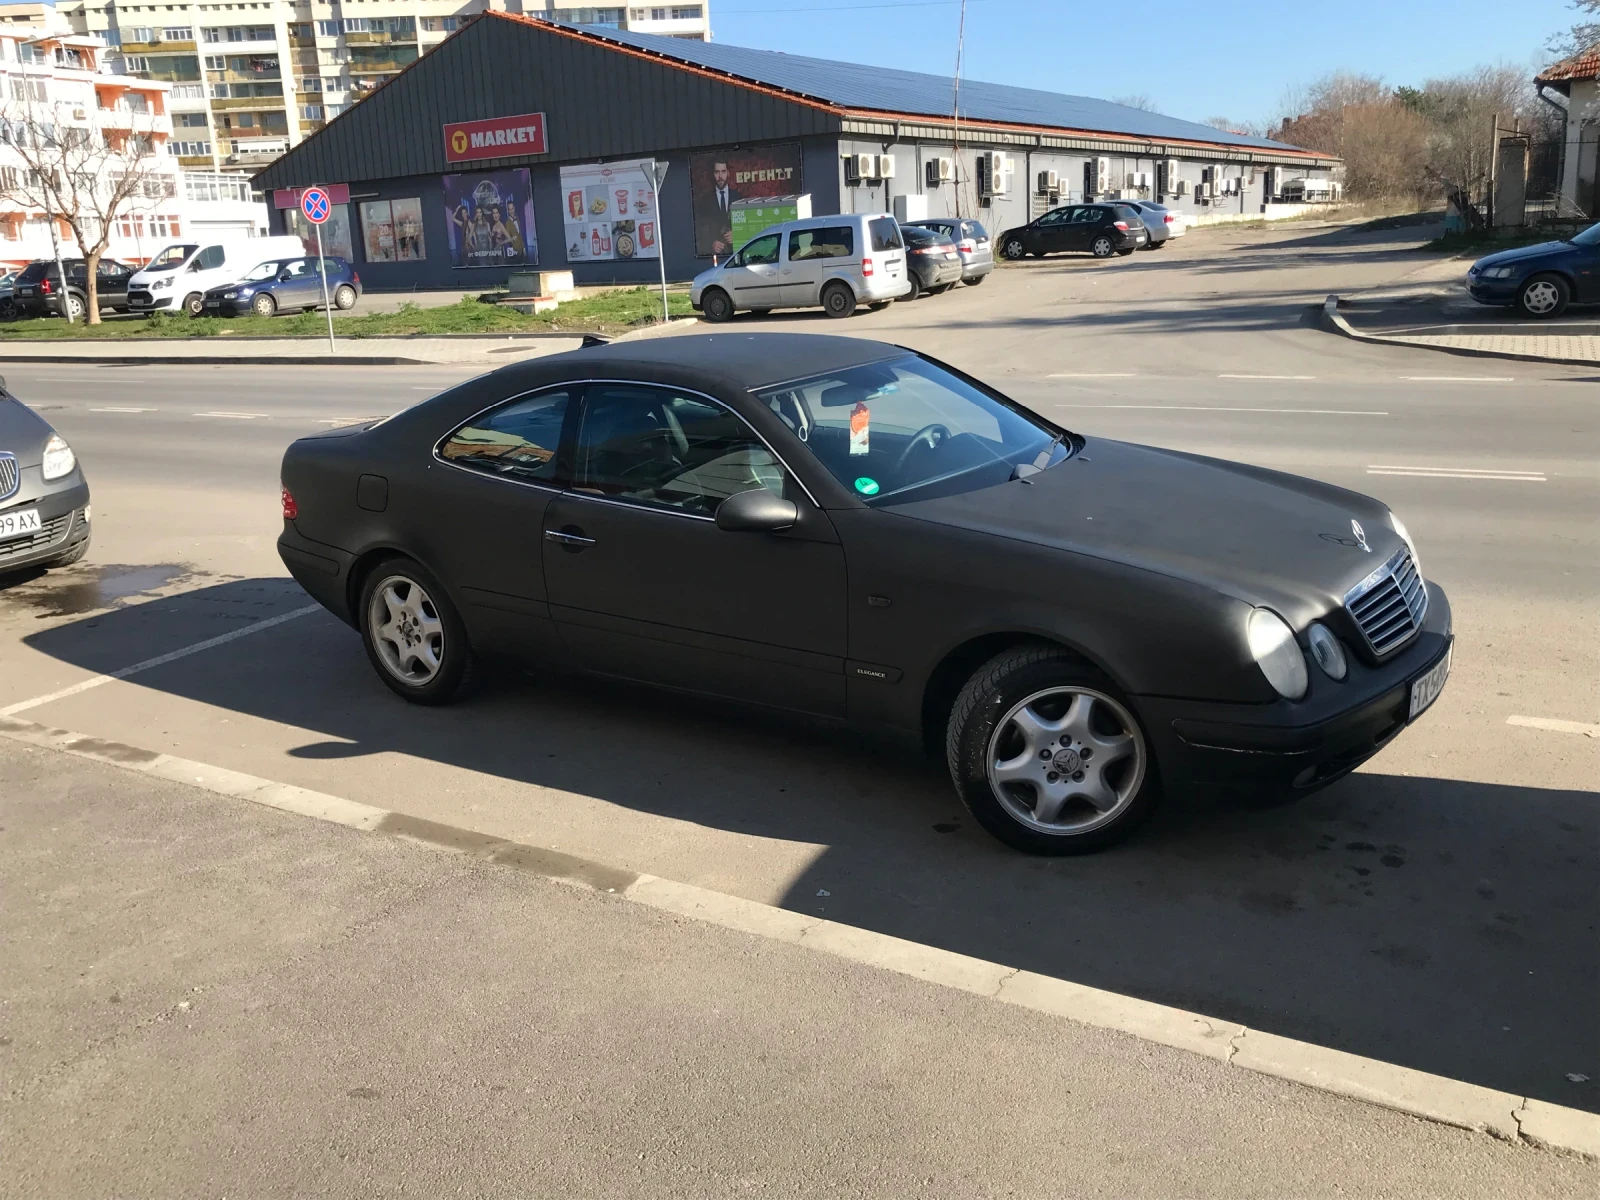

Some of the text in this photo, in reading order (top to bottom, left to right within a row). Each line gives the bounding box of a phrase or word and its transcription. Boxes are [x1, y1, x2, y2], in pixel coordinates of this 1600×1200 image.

[455, 126, 536, 150] T MARKET
[732, 210, 745, 218] BOX
[19, 512, 38, 530] AX
[856, 668, 886, 679] ELEGANCE
